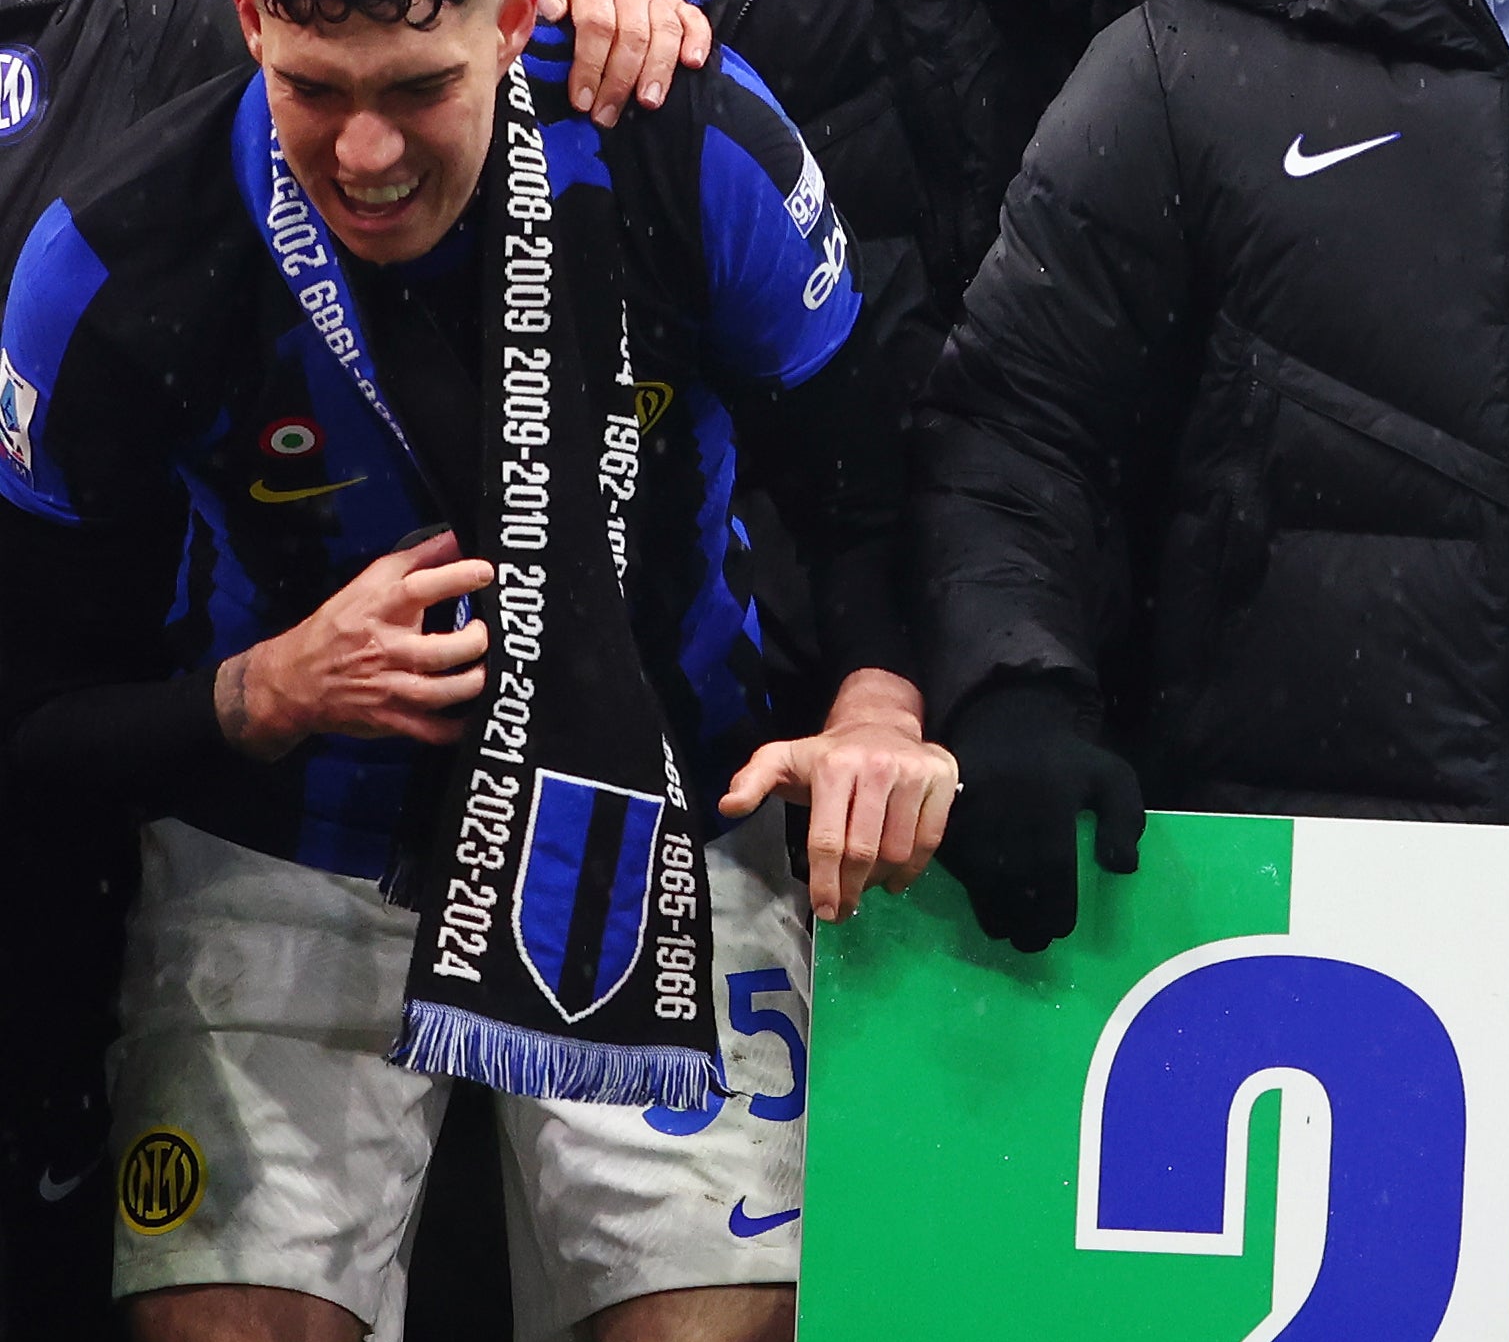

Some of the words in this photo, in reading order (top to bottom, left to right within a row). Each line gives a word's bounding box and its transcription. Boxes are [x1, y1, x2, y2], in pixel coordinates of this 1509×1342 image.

[504, 121, 554, 335] 2008-2009
[500, 345, 551, 551] 2009-2010
[480, 563, 547, 764] 2020-2021
[432, 768, 521, 984] 2023-2024
[654, 832, 698, 1021] 1965-1966
